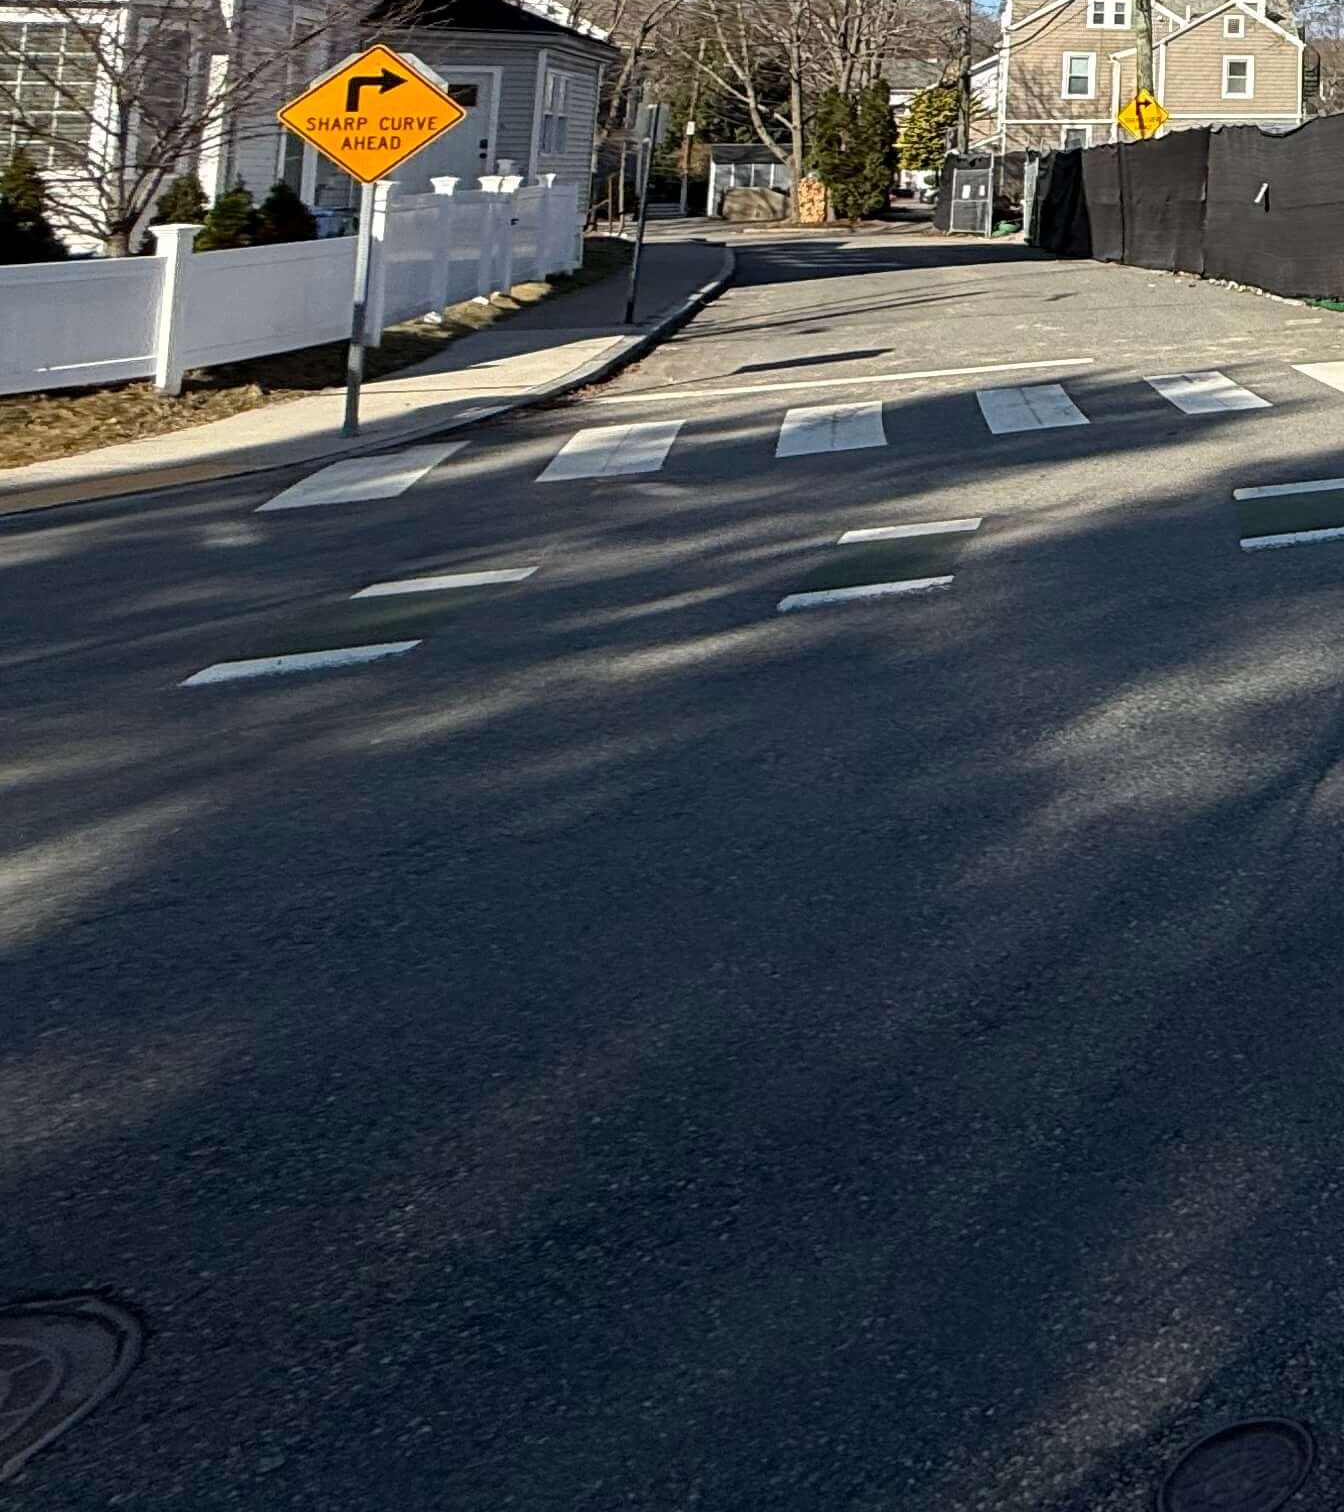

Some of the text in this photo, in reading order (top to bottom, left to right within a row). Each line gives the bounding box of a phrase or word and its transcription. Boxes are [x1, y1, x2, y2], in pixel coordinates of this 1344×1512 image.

[306, 115, 439, 132] SHARP CURVE
[341, 136, 401, 151] AHEAD
